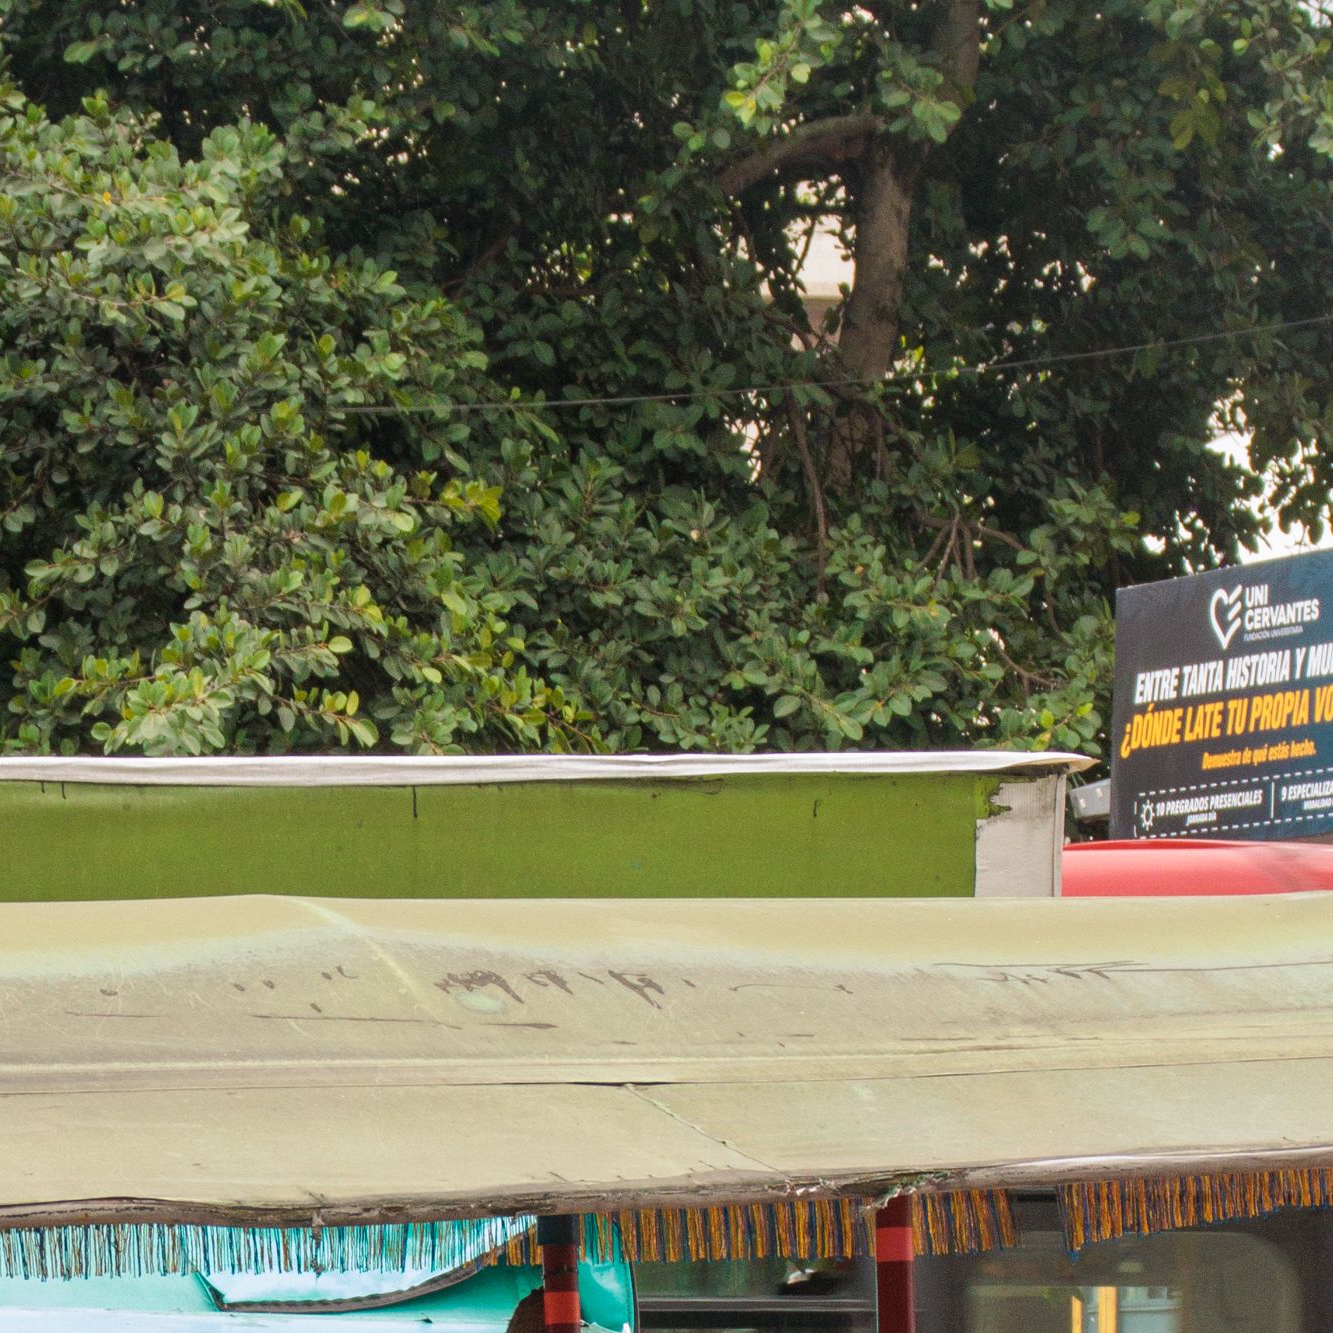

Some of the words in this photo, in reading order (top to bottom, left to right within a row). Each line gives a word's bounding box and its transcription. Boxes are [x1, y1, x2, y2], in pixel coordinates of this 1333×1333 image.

[1245, 584, 1269, 608] UNI
[1244, 598, 1321, 630] CERVANTES
[1133, 667, 1180, 704] ENTRE
[1181, 660, 1224, 697] TANTA
[1225, 649, 1291, 690] HISTORIA
[1295, 646, 1307, 680] Y
[1120, 703, 1184, 758] ¿DÓNDE
[1184, 701, 1225, 742] LATE
[1226, 698, 1250, 736] TU
[1248, 688, 1311, 732] PROPIA
[1202, 749, 1242, 770] Demuestra
[1242, 746, 1253, 765] de
[1252, 743, 1268, 767] qué
[1290, 738, 1316, 758] hecho.
[1155, 801, 1165, 817] 10
[1166, 796, 1209, 815] PREGRADOS
[1209, 789, 1263, 810] PRESENCIALES
[1281, 786, 1287, 801] 9
